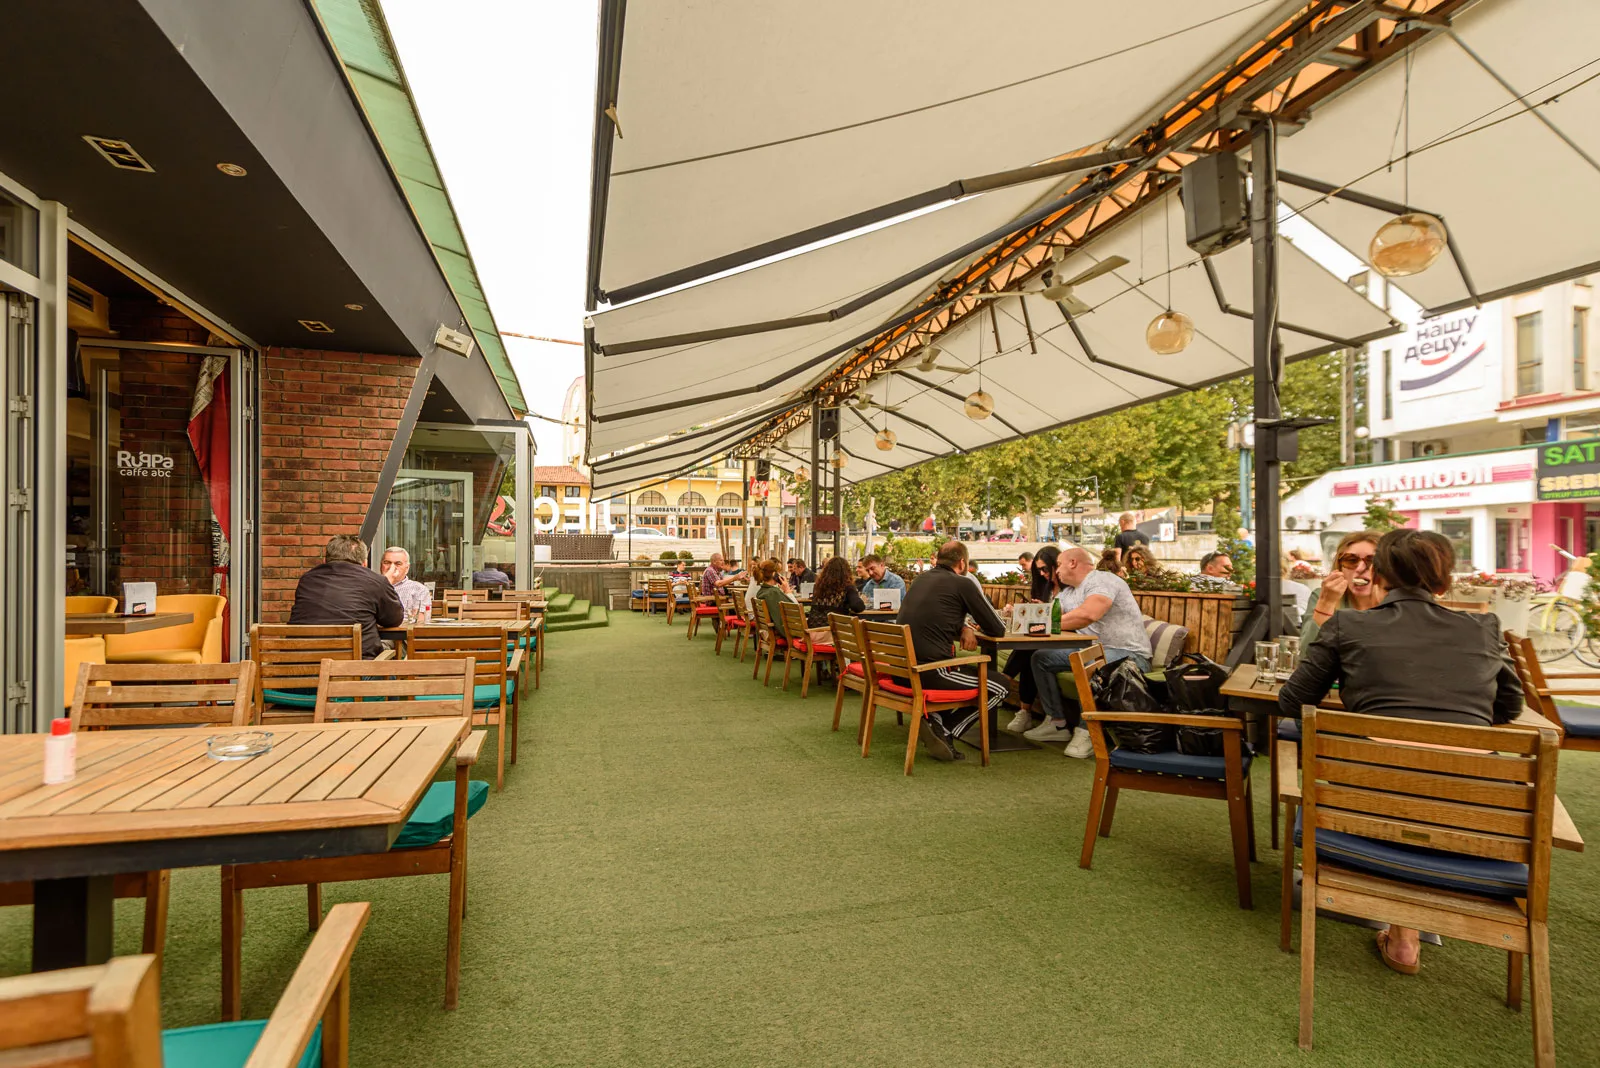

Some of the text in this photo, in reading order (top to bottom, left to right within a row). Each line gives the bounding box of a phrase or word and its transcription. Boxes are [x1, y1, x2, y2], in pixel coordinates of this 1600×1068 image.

[1416, 314, 1478, 342] нашу
[1404, 334, 1467, 363] децу.
[120, 467, 172, 478] caffe abc
[1540, 473, 1600, 492] SREB
